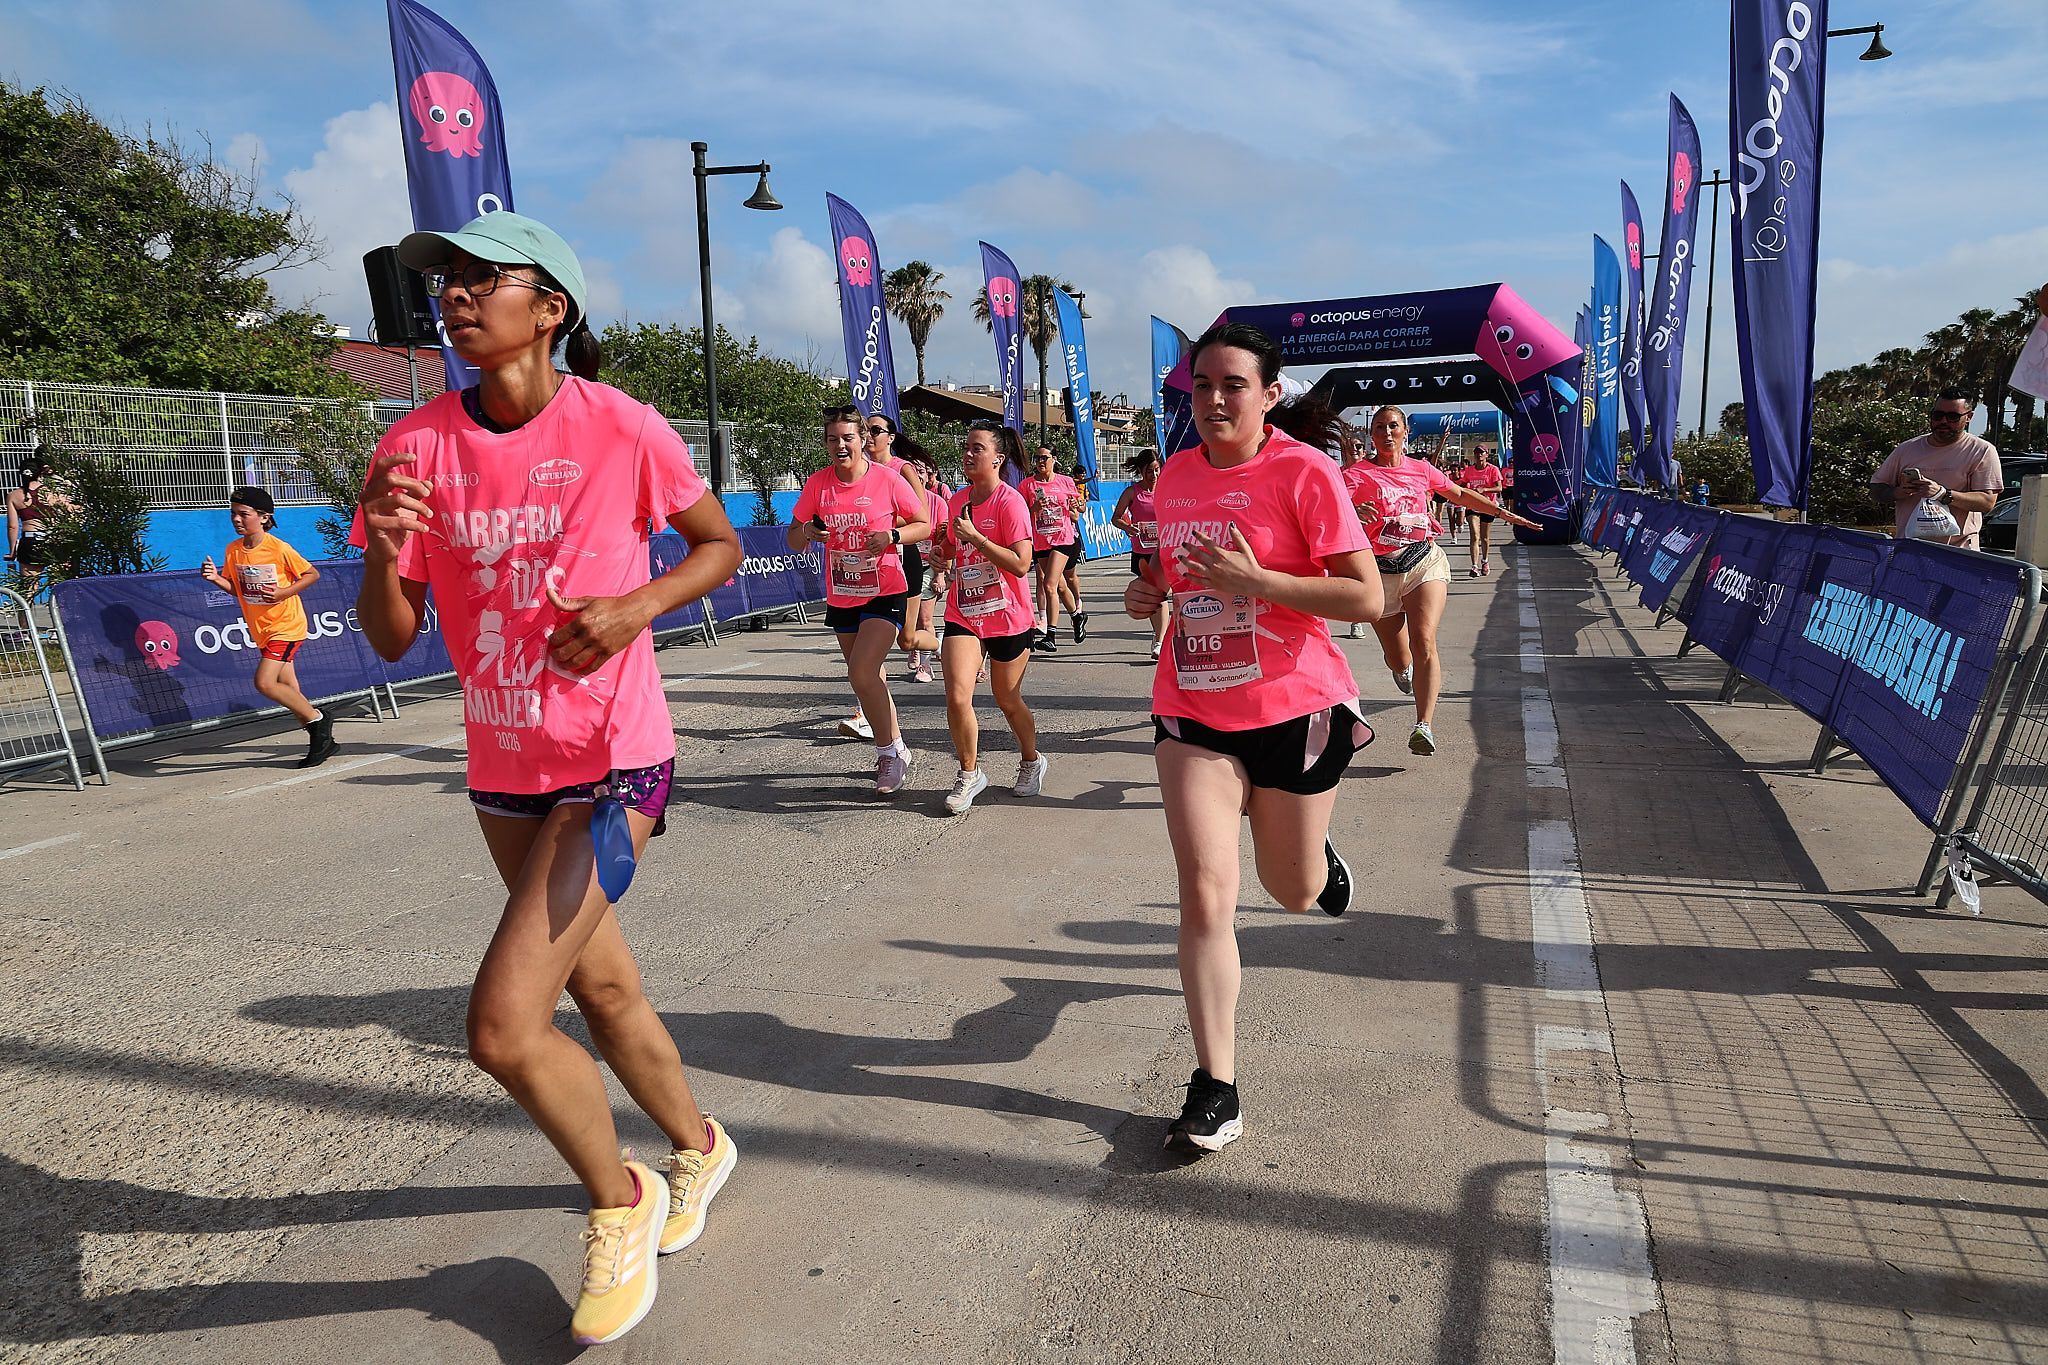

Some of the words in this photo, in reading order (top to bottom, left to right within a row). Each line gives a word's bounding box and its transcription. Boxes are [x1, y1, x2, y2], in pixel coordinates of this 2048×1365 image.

[1310, 310, 1371, 325] octopus
[1372, 305, 1425, 321] energy
[1282, 335, 1296, 344] LA
[1299, 330, 1346, 343] ENERGÍA
[1350, 328, 1380, 340] PARA
[1383, 326, 1430, 338] CORRER
[1281, 347, 1289, 356] A
[1292, 346, 1306, 355] LA
[1309, 343, 1372, 354] VELOCIDAD
[1375, 341, 1390, 350] DE
[1393, 339, 1407, 349] LA
[1410, 338, 1433, 347] LUZ
[1355, 374, 1477, 390] VOLVO
[534, 470, 578, 482] ASTURIANA
[1518, 468, 1547, 478] octopus
[1165, 498, 1197, 509] OYSHO
[440, 503, 564, 549] CARRERA
[824, 512, 868, 528] CARRERA
[848, 531, 863, 550] DE
[783, 551, 821, 574] energy
[844, 571, 861, 580] 016
[1712, 565, 1751, 603] octopus
[965, 586, 985, 597] 016
[1184, 604, 1221, 615] ASTURIANA
[1187, 634, 1222, 653] 016
[1802, 580, 1966, 721] ¡ENHORABUENA!
[1195, 654, 1213, 664] 2778
[1222, 661, 1247, 669] VALENCIA
[1217, 672, 1249, 682] Santander
[465, 685, 544, 728] MUJER
[496, 731, 522, 753] 2026
